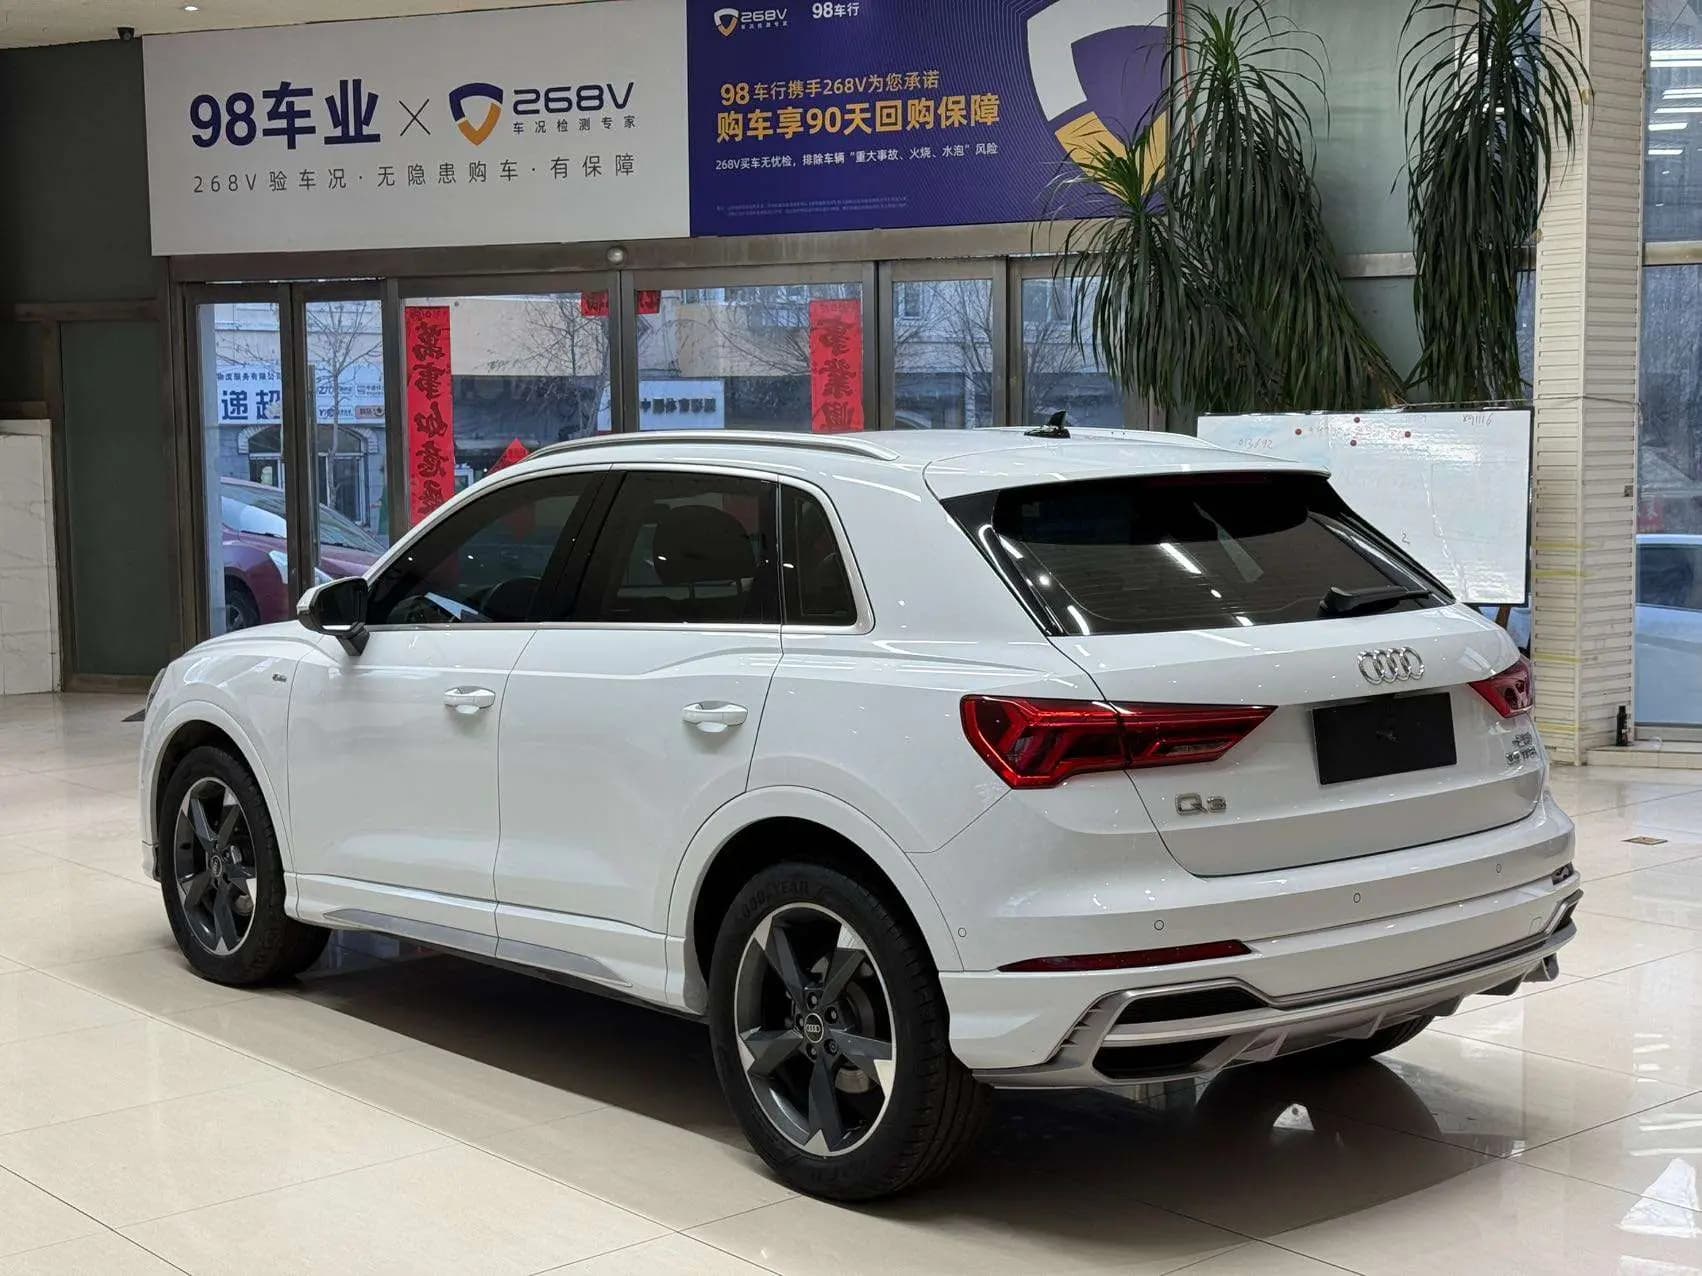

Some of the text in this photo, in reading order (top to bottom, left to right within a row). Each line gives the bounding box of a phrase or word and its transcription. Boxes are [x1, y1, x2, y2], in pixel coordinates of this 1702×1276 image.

[741, 8, 787, 22] 268V
[812, 2, 860, 18] 98车行
[513, 82, 634, 115] 268V
[190, 79, 381, 149] 98车业
[513, 115, 636, 135] 车况检测专家
[717, 93, 1000, 143] 购车享90天回购保障
[1175, 793, 1226, 816] Q3
